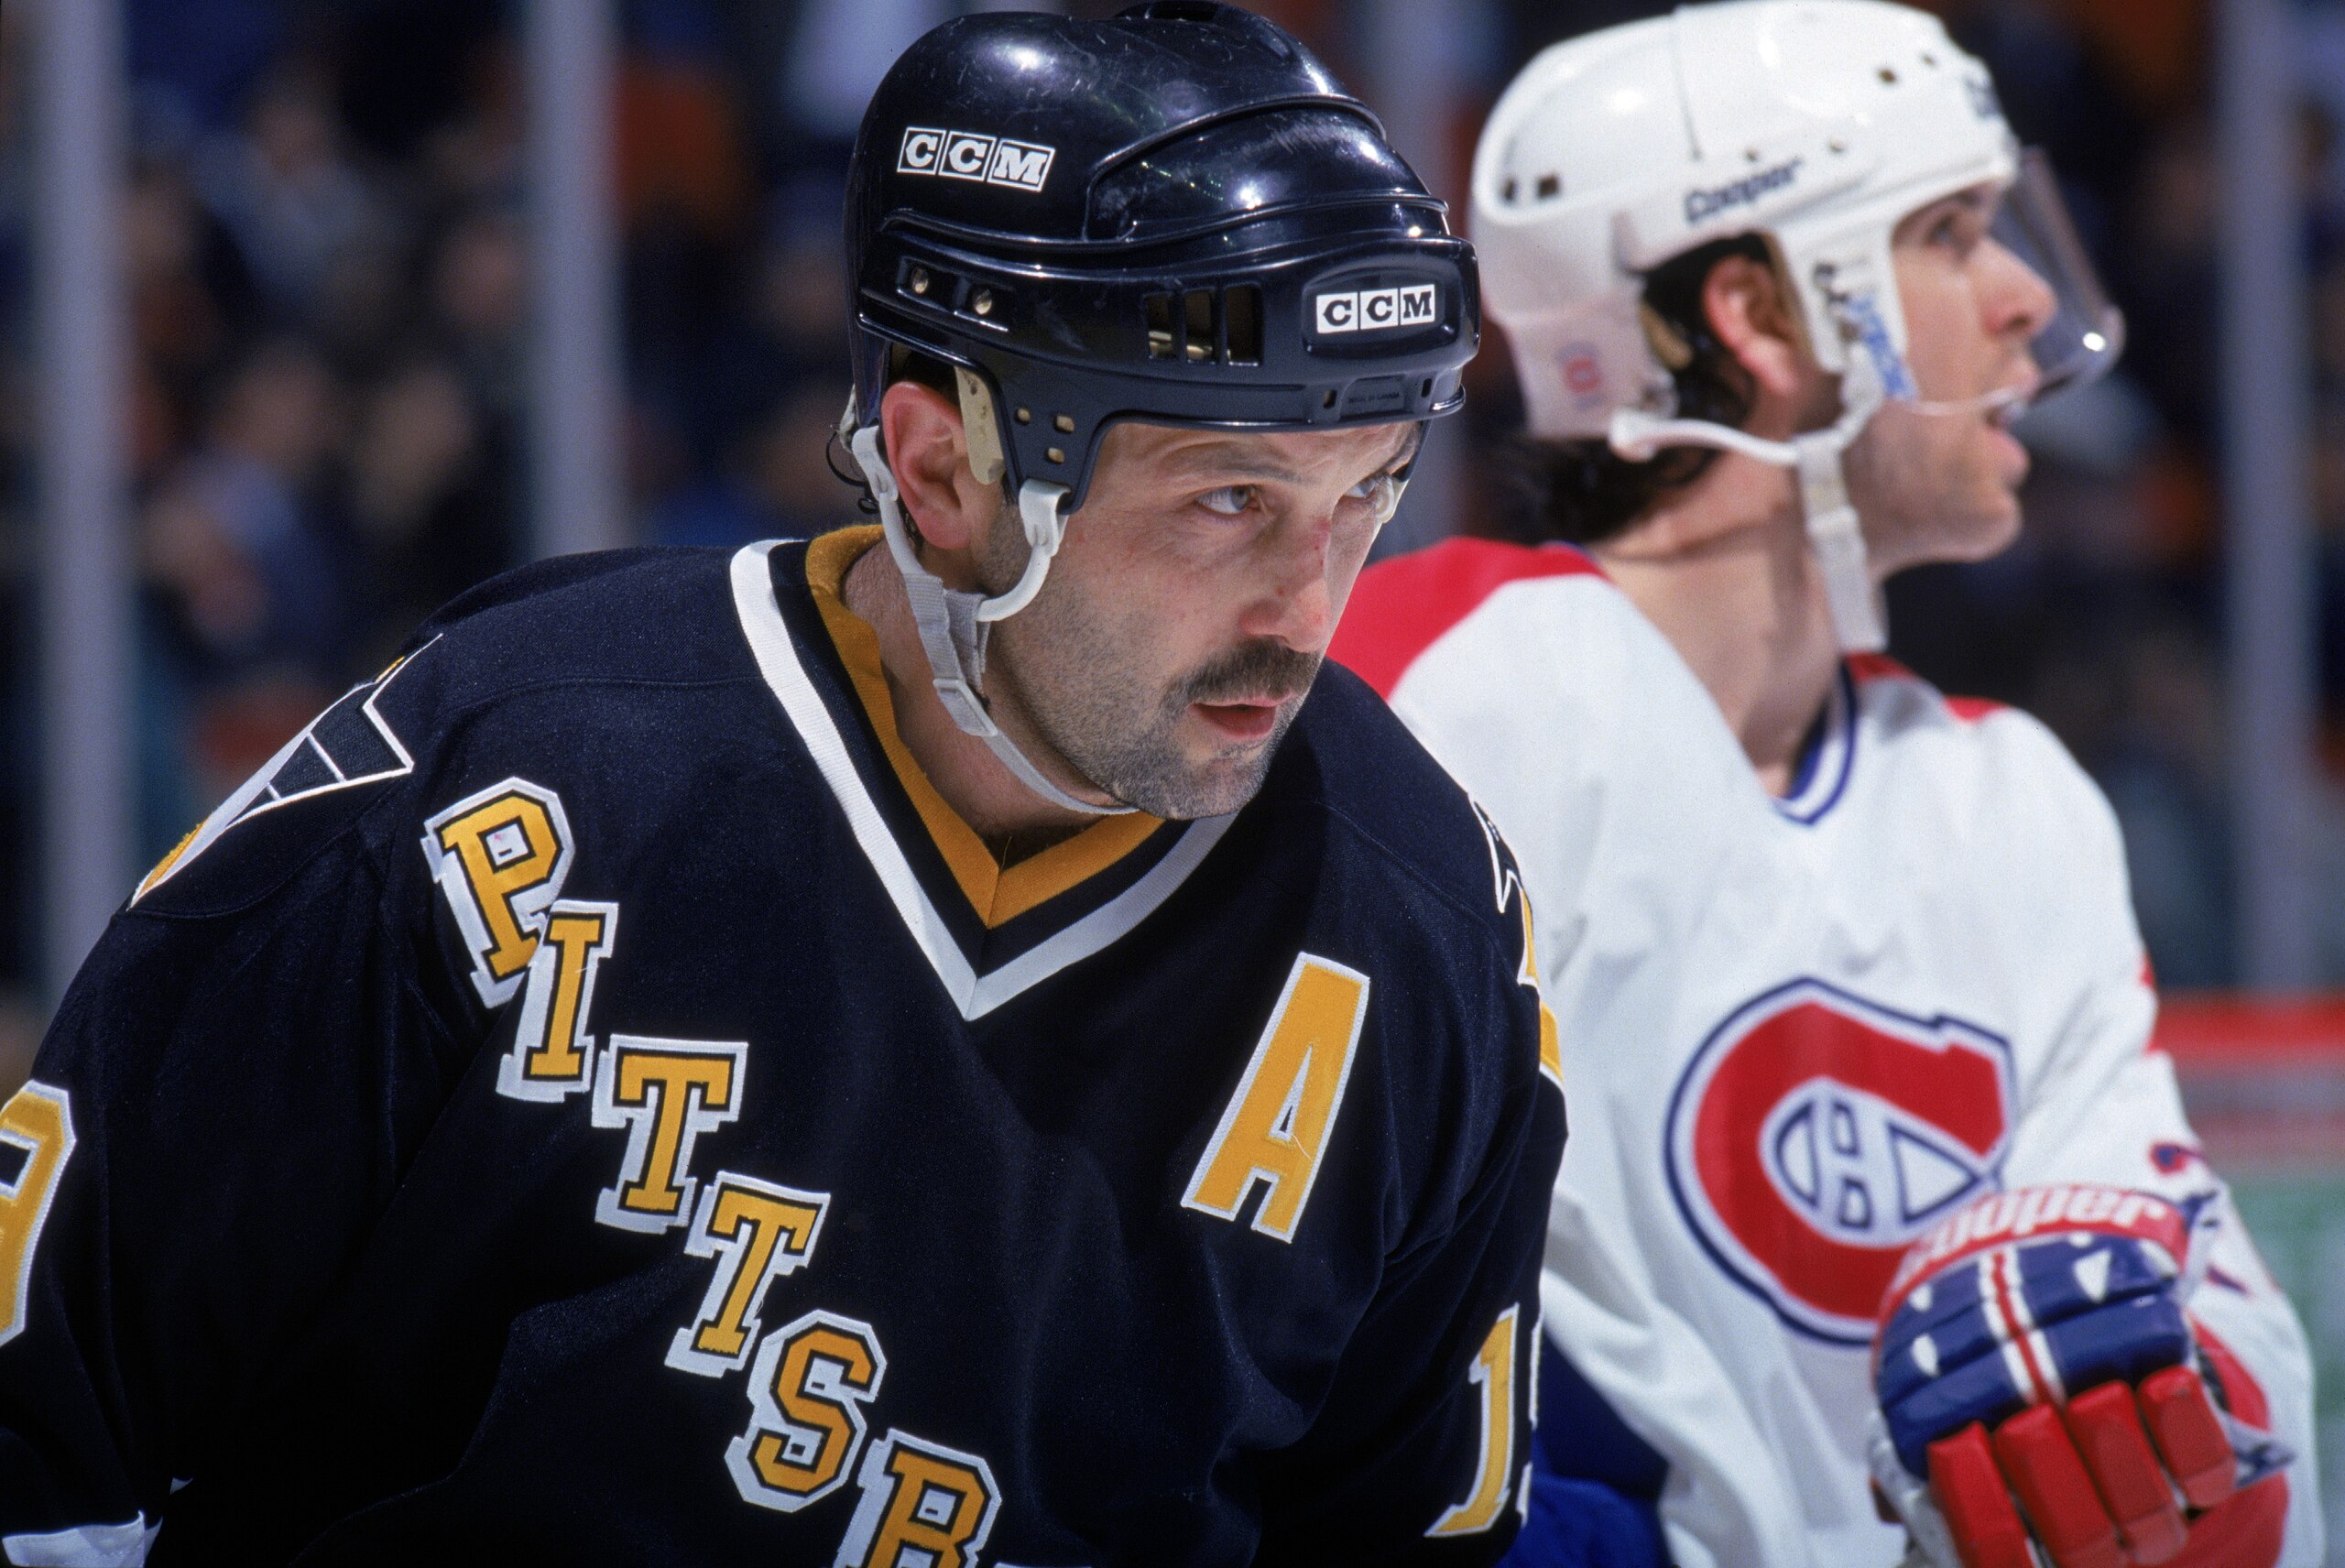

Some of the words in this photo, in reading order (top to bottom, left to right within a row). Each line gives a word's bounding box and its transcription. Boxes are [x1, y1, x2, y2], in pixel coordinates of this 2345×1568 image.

[902, 132, 1052, 186] CCM
[1685, 157, 1804, 223] Cooper
[1322, 289, 1433, 327] CCM
[420, 777, 1092, 1568] PITTSB
[1180, 952, 1370, 1244] A
[1423, 1301, 1542, 1537] 1
